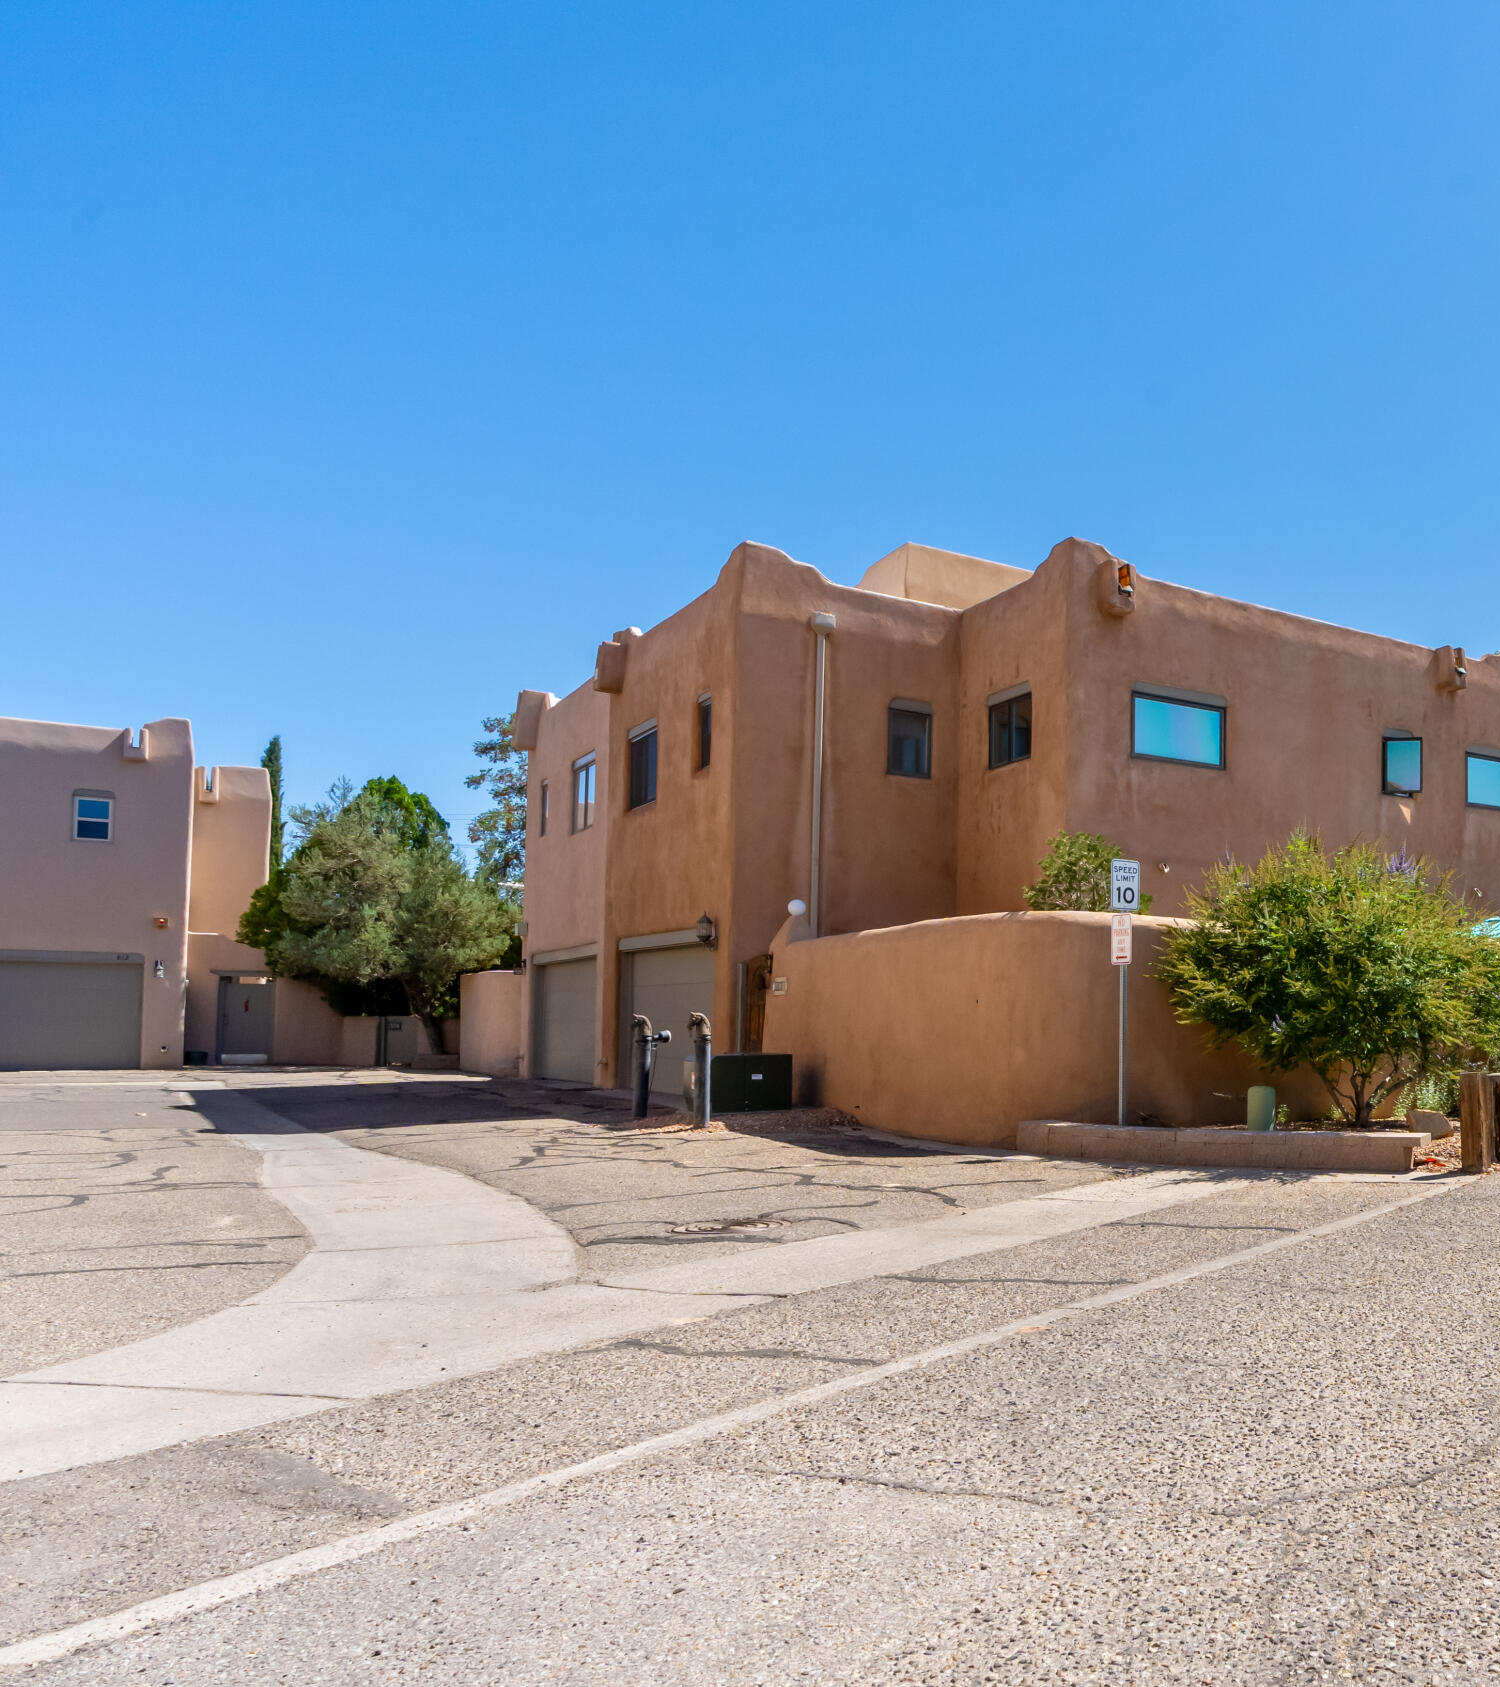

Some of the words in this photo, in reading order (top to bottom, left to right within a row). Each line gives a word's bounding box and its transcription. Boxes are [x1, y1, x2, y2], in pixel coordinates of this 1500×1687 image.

[1114, 866, 1137, 874] SPEED
[1116, 887, 1135, 903] 10
[1113, 928, 1129, 937] PARKING
